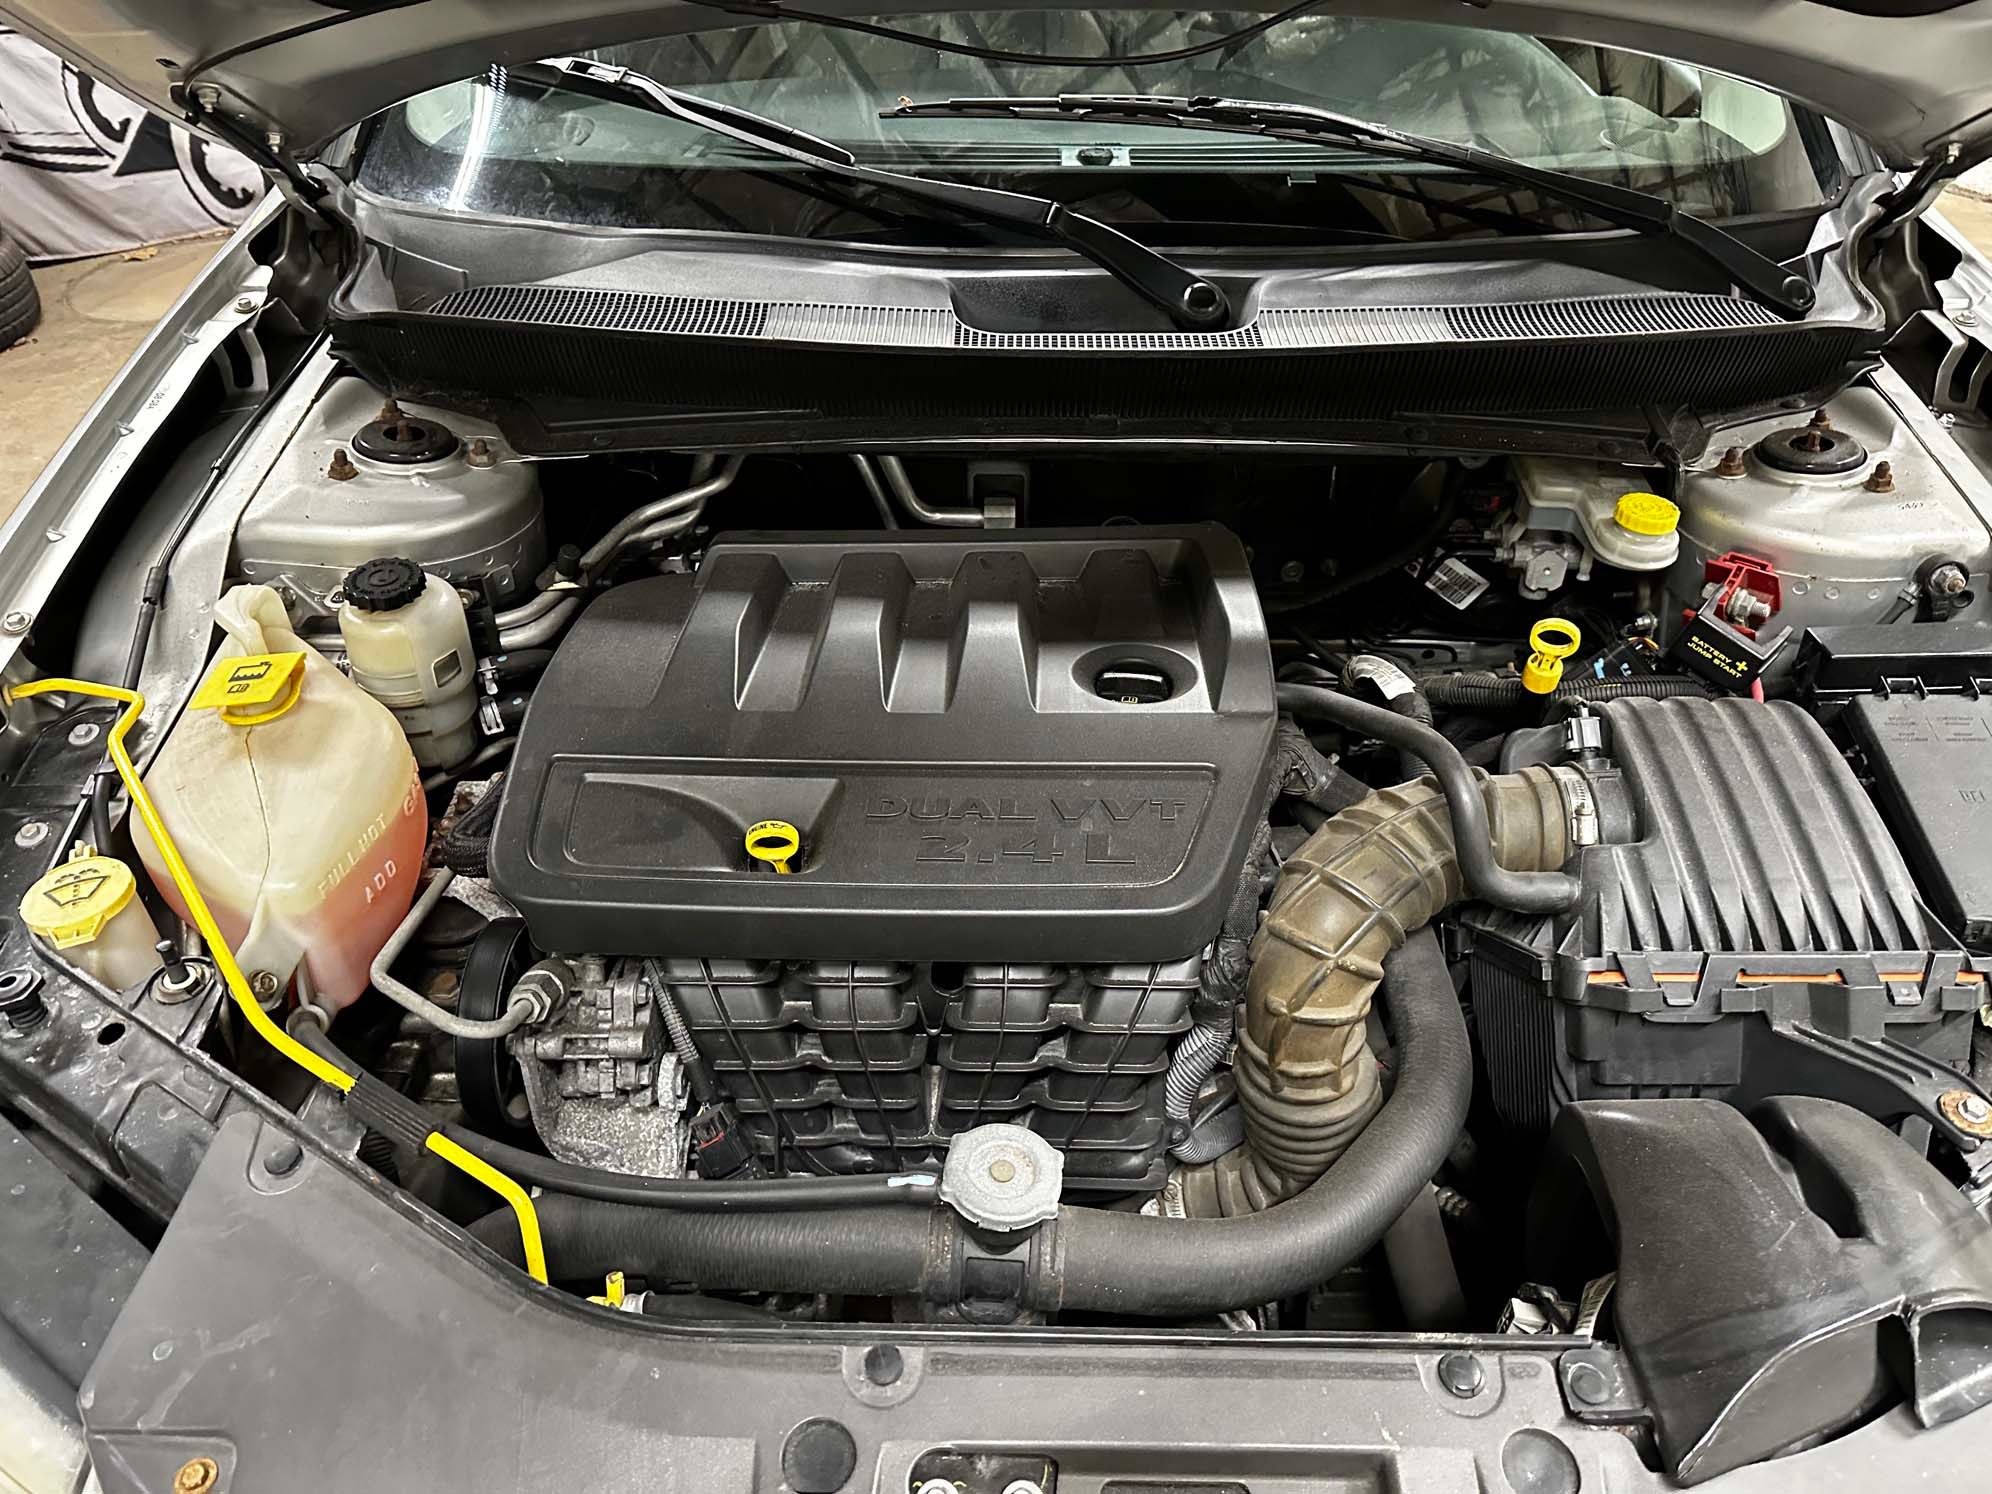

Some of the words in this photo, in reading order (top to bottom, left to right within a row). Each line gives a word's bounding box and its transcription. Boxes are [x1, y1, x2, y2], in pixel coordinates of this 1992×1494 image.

[1687, 642, 1713, 659] JUMP
[1713, 658, 1743, 678] START
[1691, 635, 1732, 663] BATTERY
[865, 797, 1037, 821] DUAL
[1050, 798, 1187, 821] VVT
[365, 859, 397, 904] ADD
